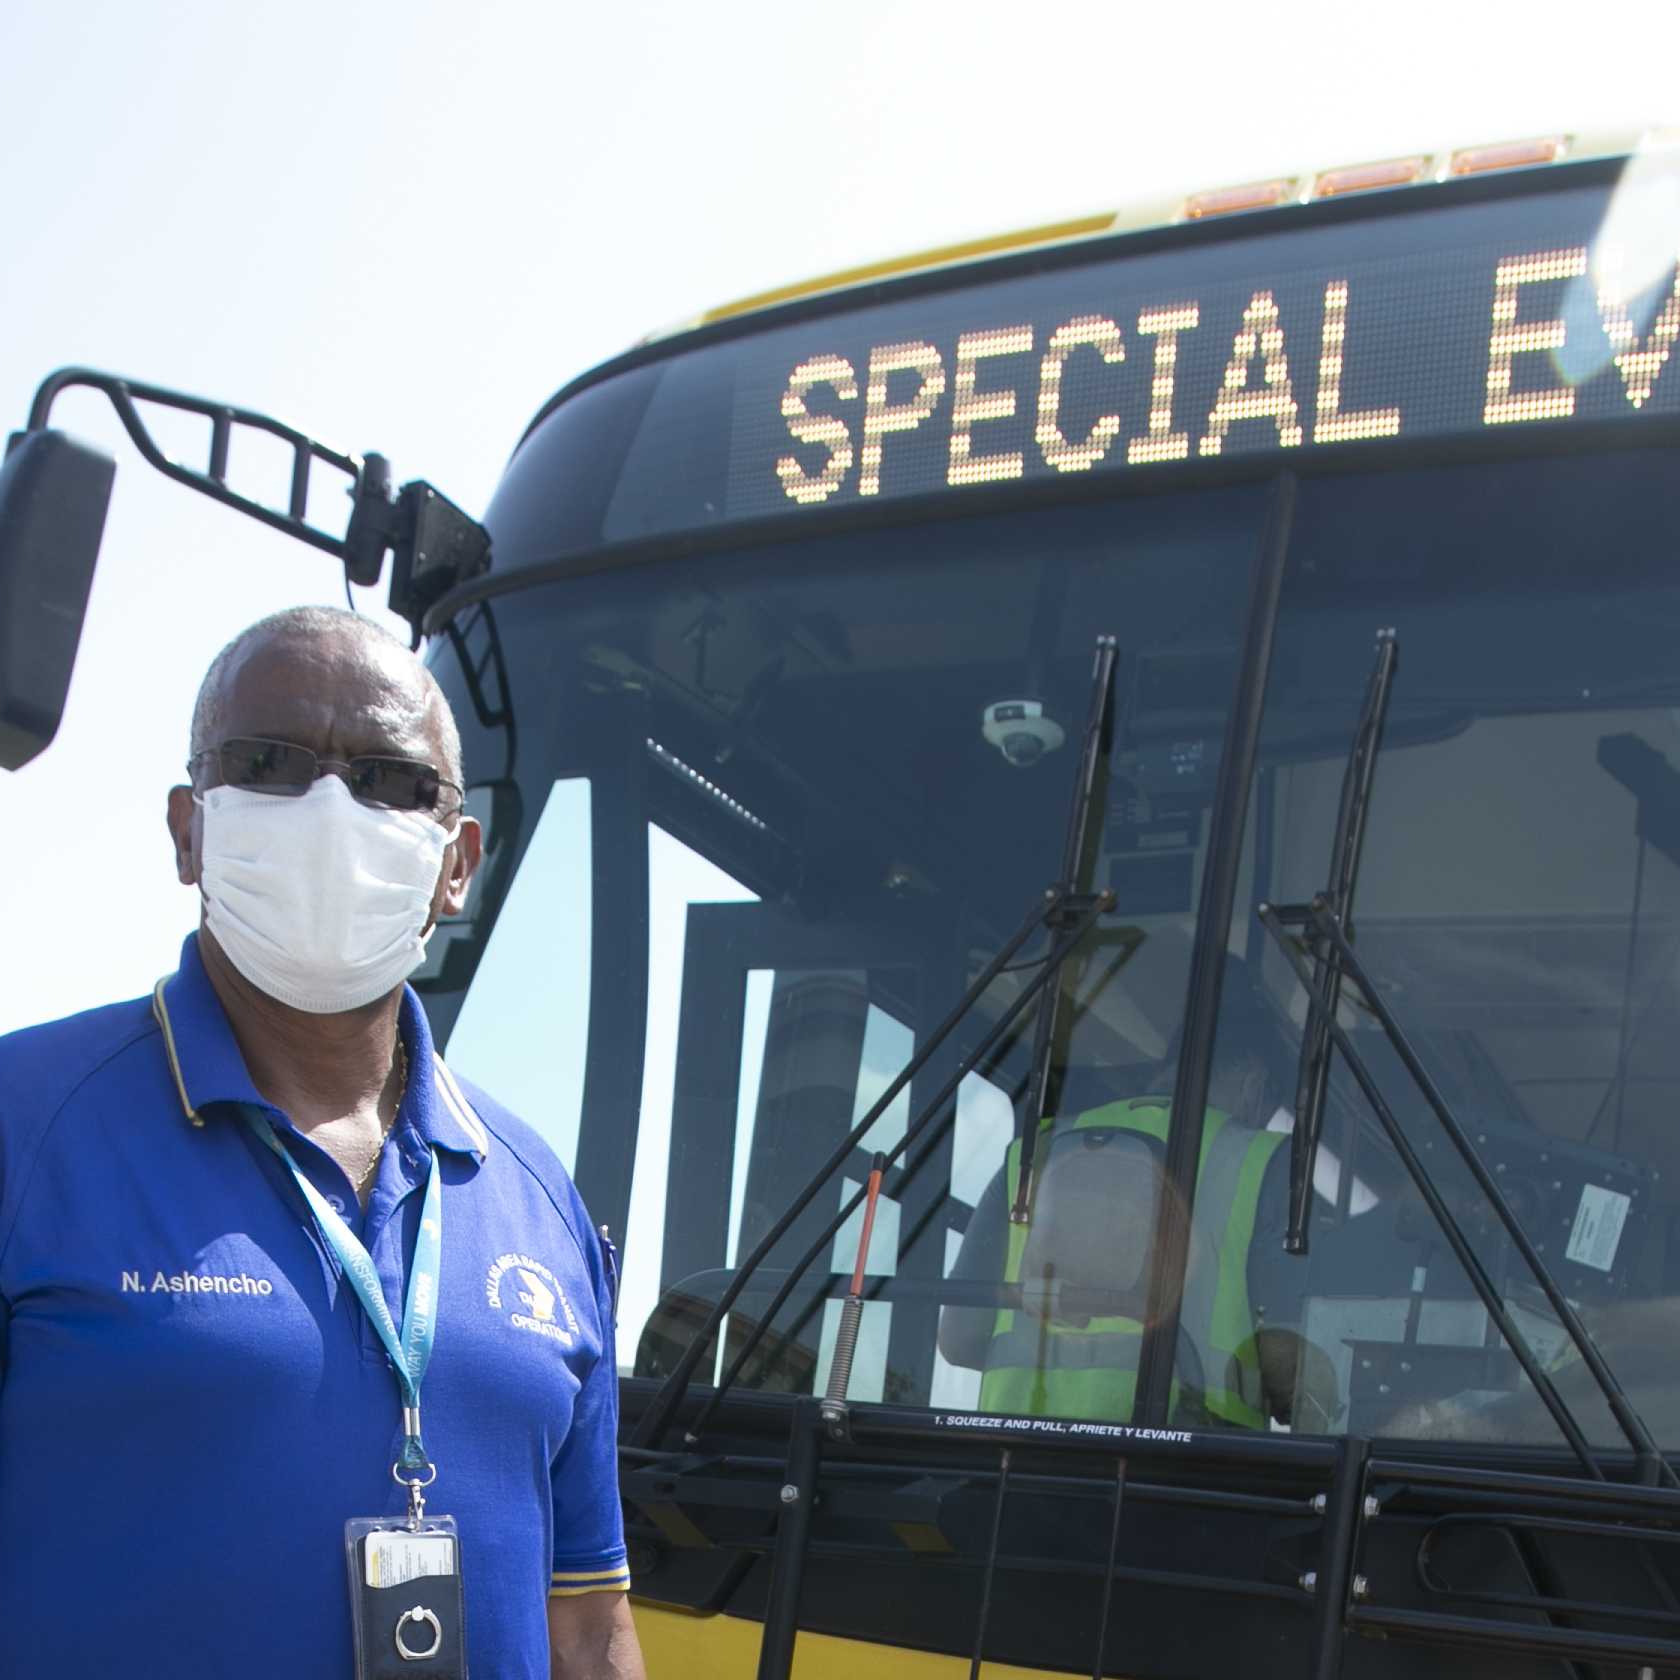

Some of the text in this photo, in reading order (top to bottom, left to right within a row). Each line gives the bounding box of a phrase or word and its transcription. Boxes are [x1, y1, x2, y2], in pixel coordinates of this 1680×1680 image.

[776, 280, 1401, 504] SPECIAL
[122, 1271, 273, 1296] N. Ashencho
[486, 1264, 504, 1308] DALLAS
[495, 1253, 523, 1273] AREA
[520, 1255, 553, 1281] RAPID
[407, 1271, 433, 1378] WAY YOU MOVE
[511, 1313, 573, 1347] OPERATIONS
[946, 1415, 1002, 1428] SQUEEZE
[1004, 1419, 1030, 1430] AND
[1032, 1420, 1067, 1434] PULL,
[1069, 1423, 1122, 1437] APRIETE
[1125, 1427, 1134, 1438] Y
[1135, 1428, 1193, 1443] LEVANTE
